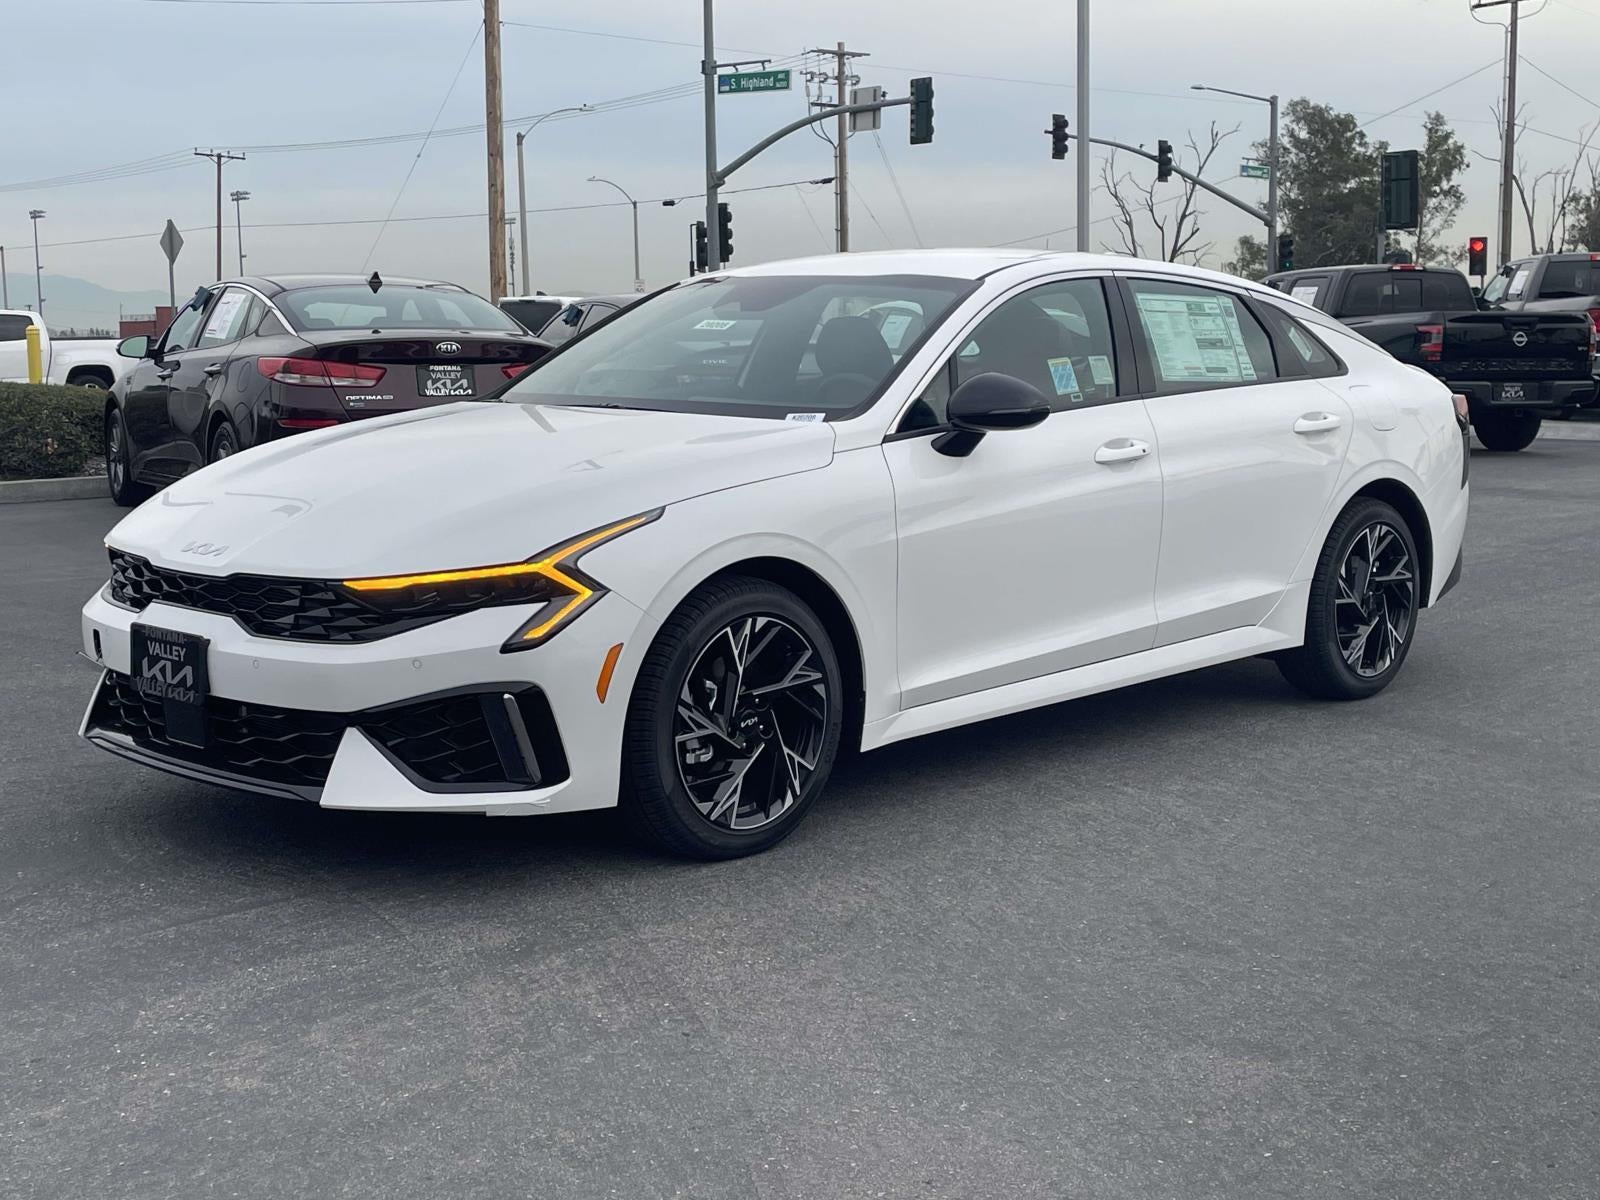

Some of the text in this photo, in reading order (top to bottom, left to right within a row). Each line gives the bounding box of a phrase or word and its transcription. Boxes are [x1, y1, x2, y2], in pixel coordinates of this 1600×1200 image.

[740, 76, 774, 90] Highland
[441, 344, 458, 352] KIA
[430, 371, 461, 379] VALLEY
[427, 378, 468, 390] KIA
[425, 388, 449, 396] VALLEY
[180, 541, 230, 557] KIA
[147, 640, 186, 662] VALLEY
[142, 656, 194, 688] KIA
[136, 675, 168, 697] VALLEY
